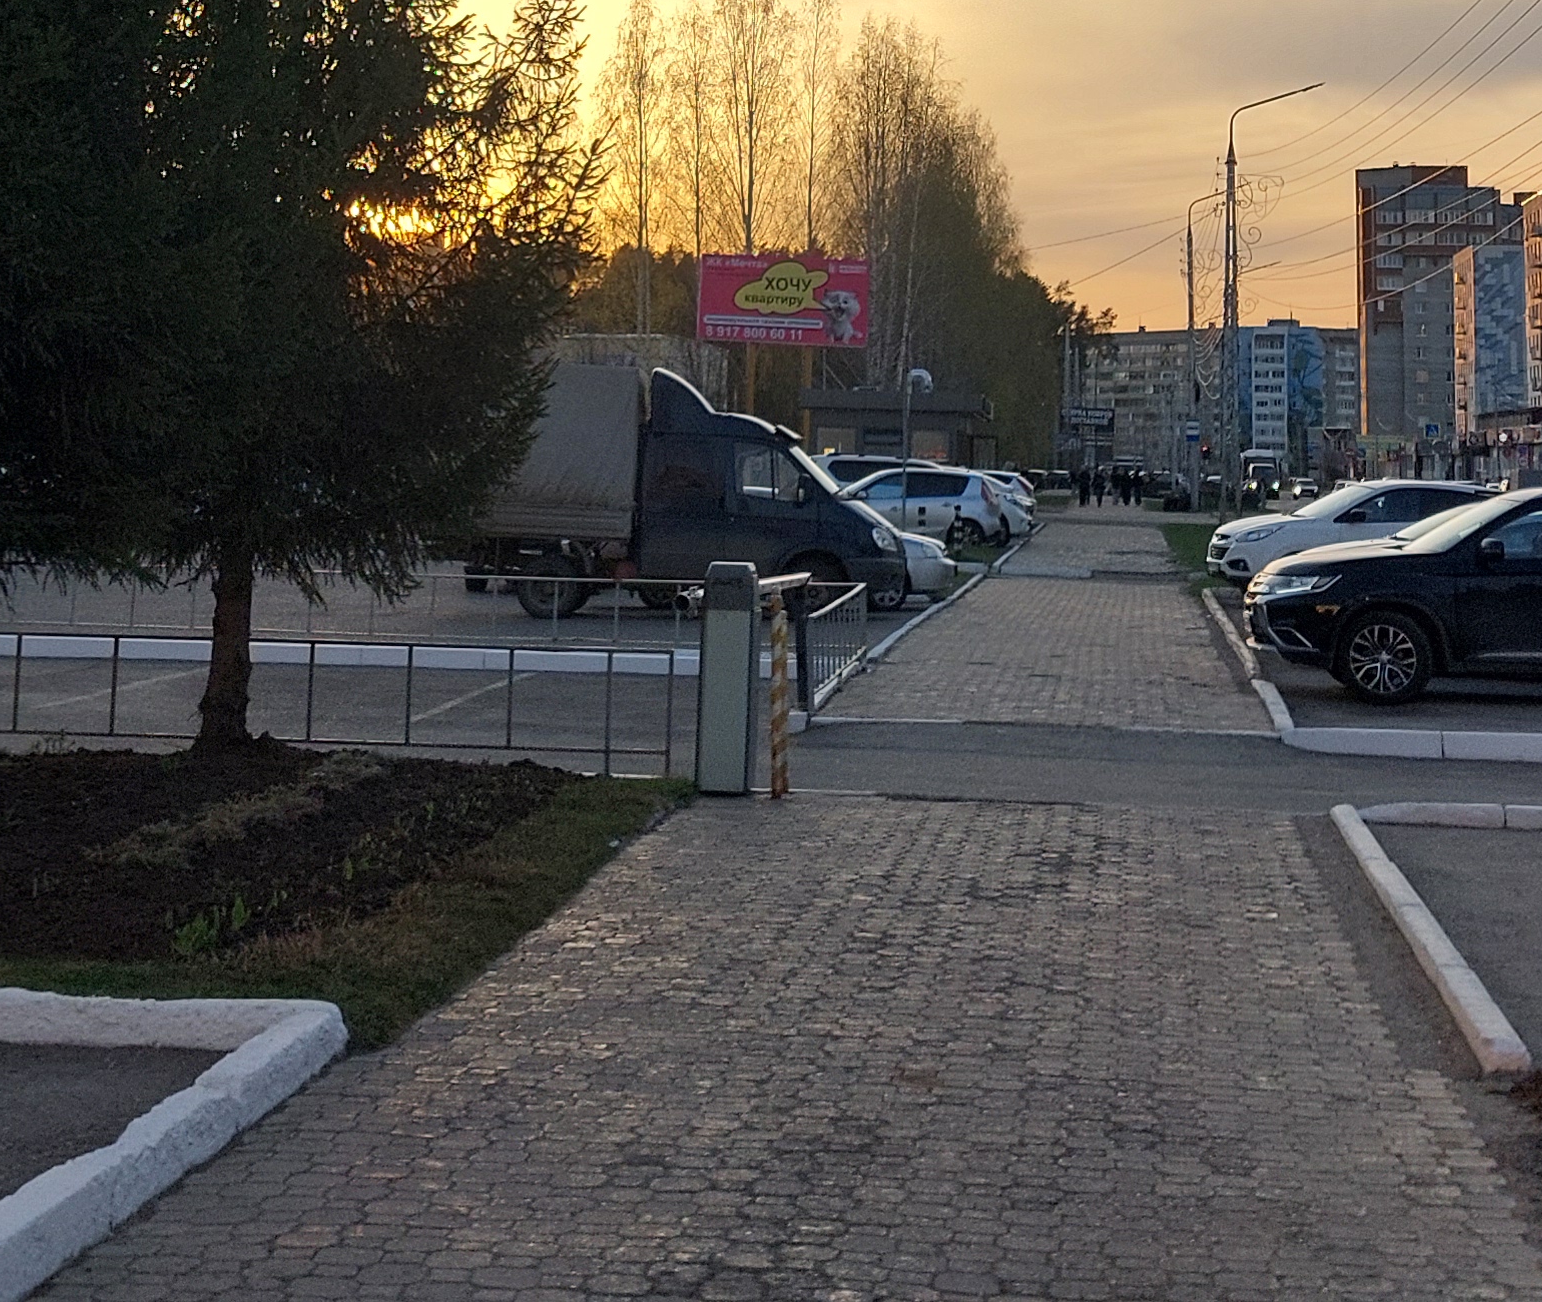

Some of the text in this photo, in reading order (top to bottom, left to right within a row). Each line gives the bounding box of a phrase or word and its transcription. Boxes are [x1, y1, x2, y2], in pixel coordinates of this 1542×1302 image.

[744, 294, 805, 307] квартиру
[716, 325, 740, 338] 917
[790, 329, 803, 341] 11
